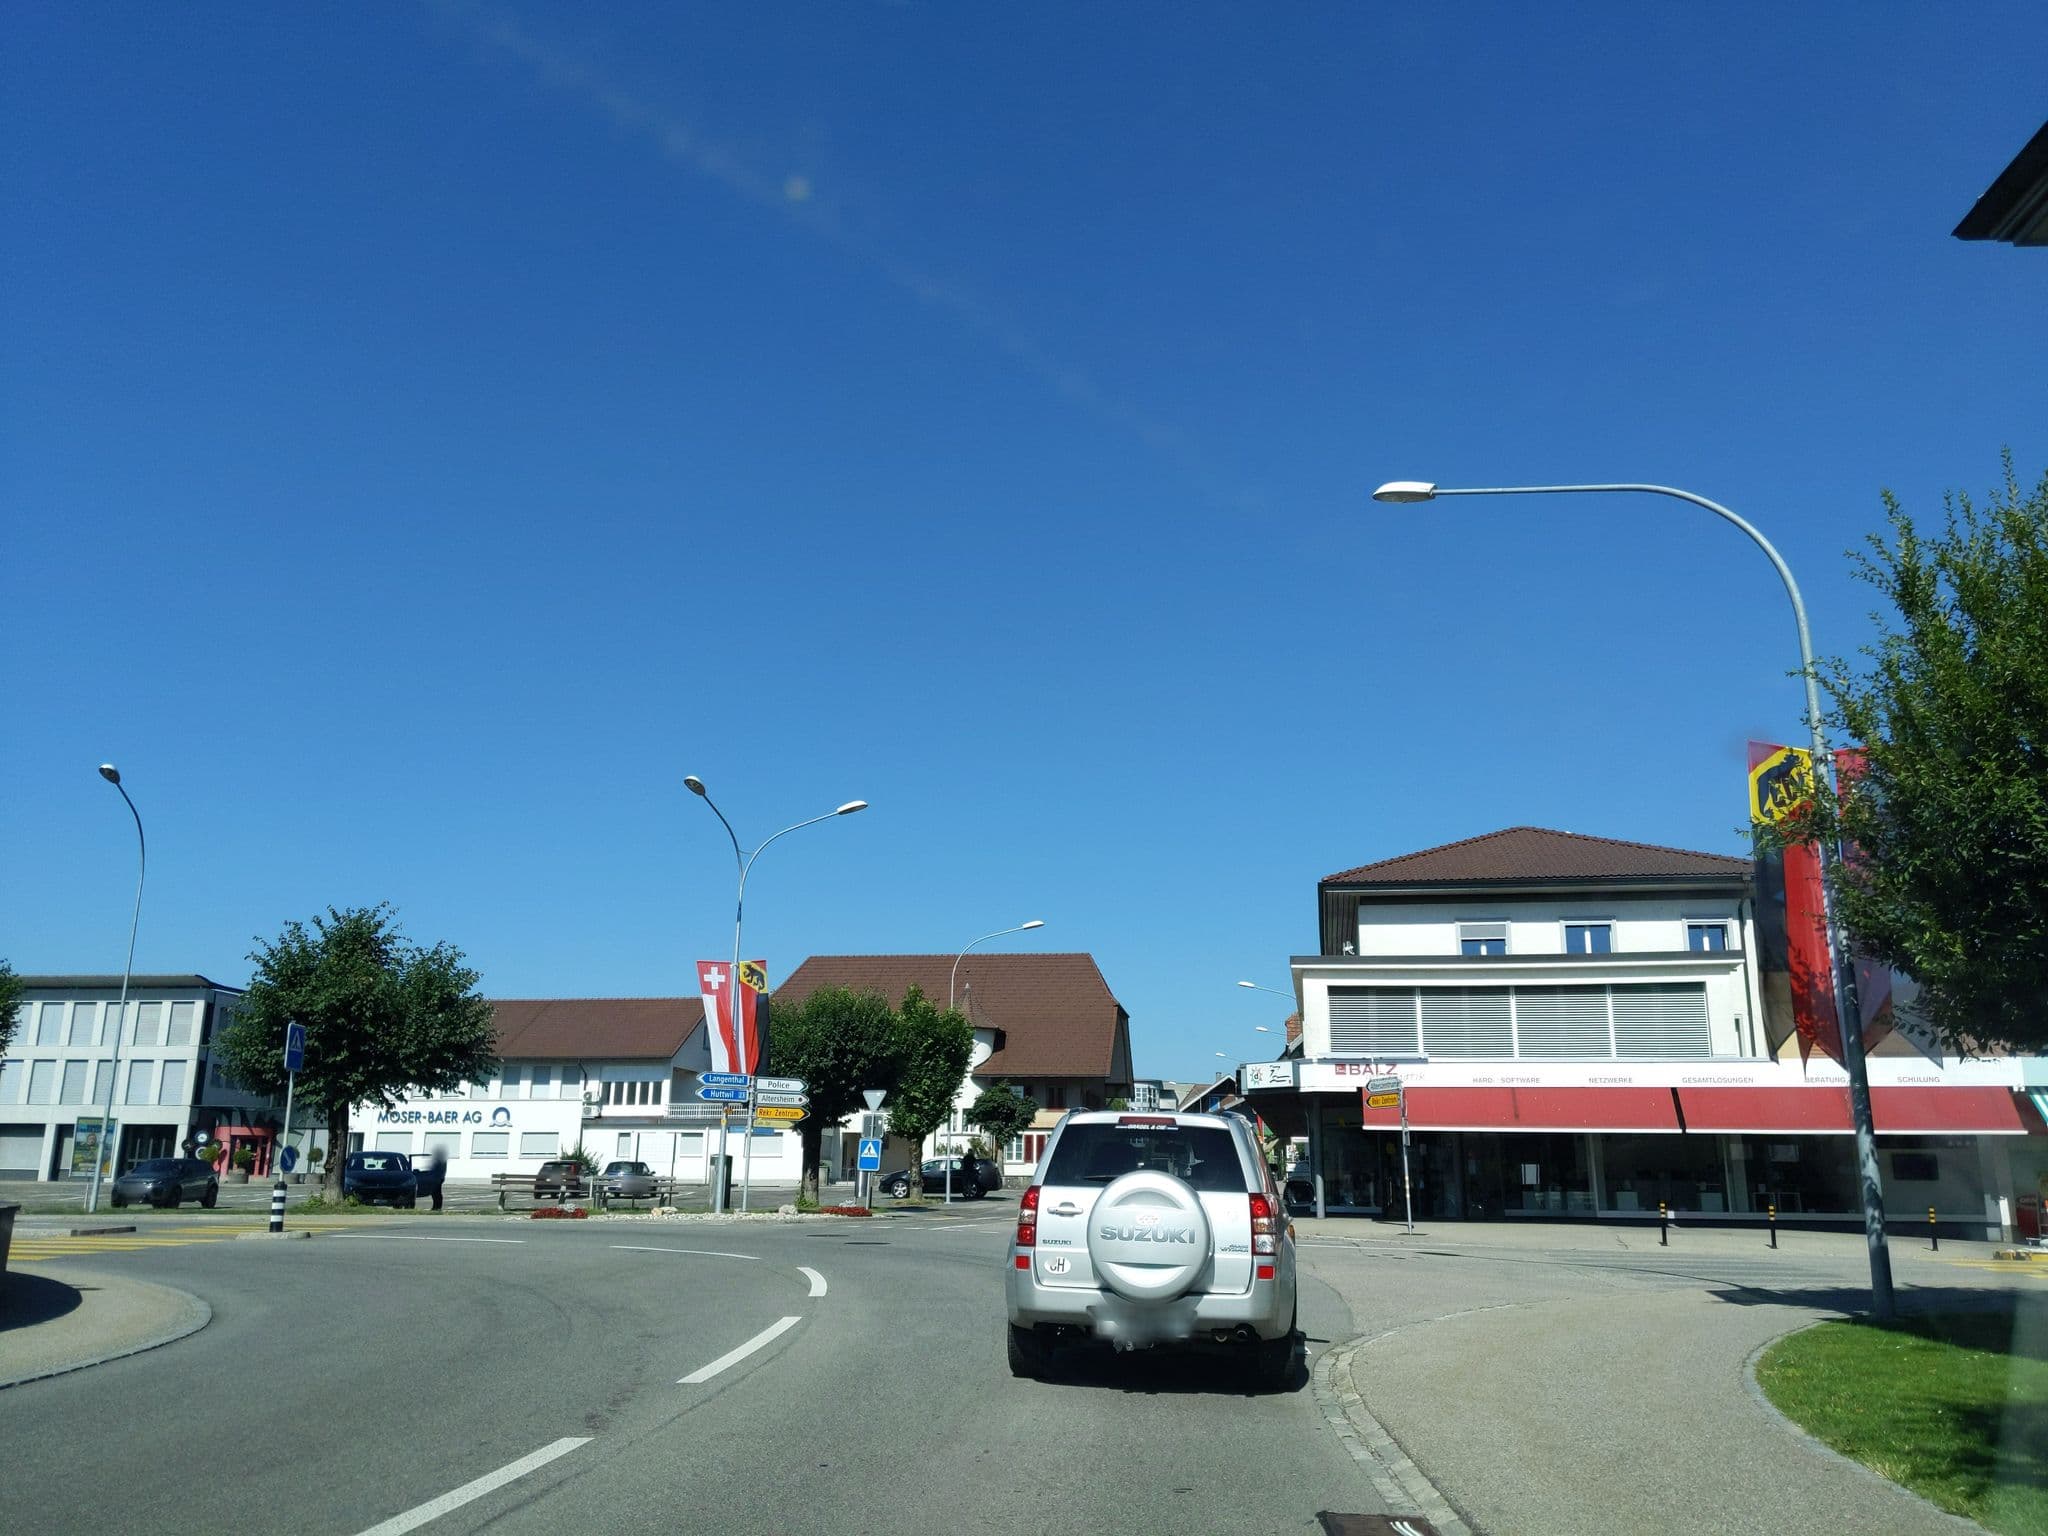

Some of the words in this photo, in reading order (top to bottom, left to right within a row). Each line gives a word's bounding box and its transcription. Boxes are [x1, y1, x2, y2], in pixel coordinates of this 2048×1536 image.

[1349, 1063, 1398, 1076] BALZ
[709, 1074, 745, 1084] Langenthal
[1500, 1076, 1541, 1084] SOFTWARE
[1588, 1076, 1633, 1084] NETZWERKE
[1804, 1076, 1846, 1084] BERATUNG
[767, 1080, 790, 1089] Police
[710, 1089, 734, 1098] Huttwil
[761, 1094, 795, 1103] Altersheim
[377, 1110, 458, 1124] MOSER-BAER
[462, 1110, 483, 1124] AG
[774, 1109, 799, 1118] Zentrum
[1100, 1226, 1196, 1244] SUZUKI
[1042, 1238, 1072, 1246] SUZUKI
